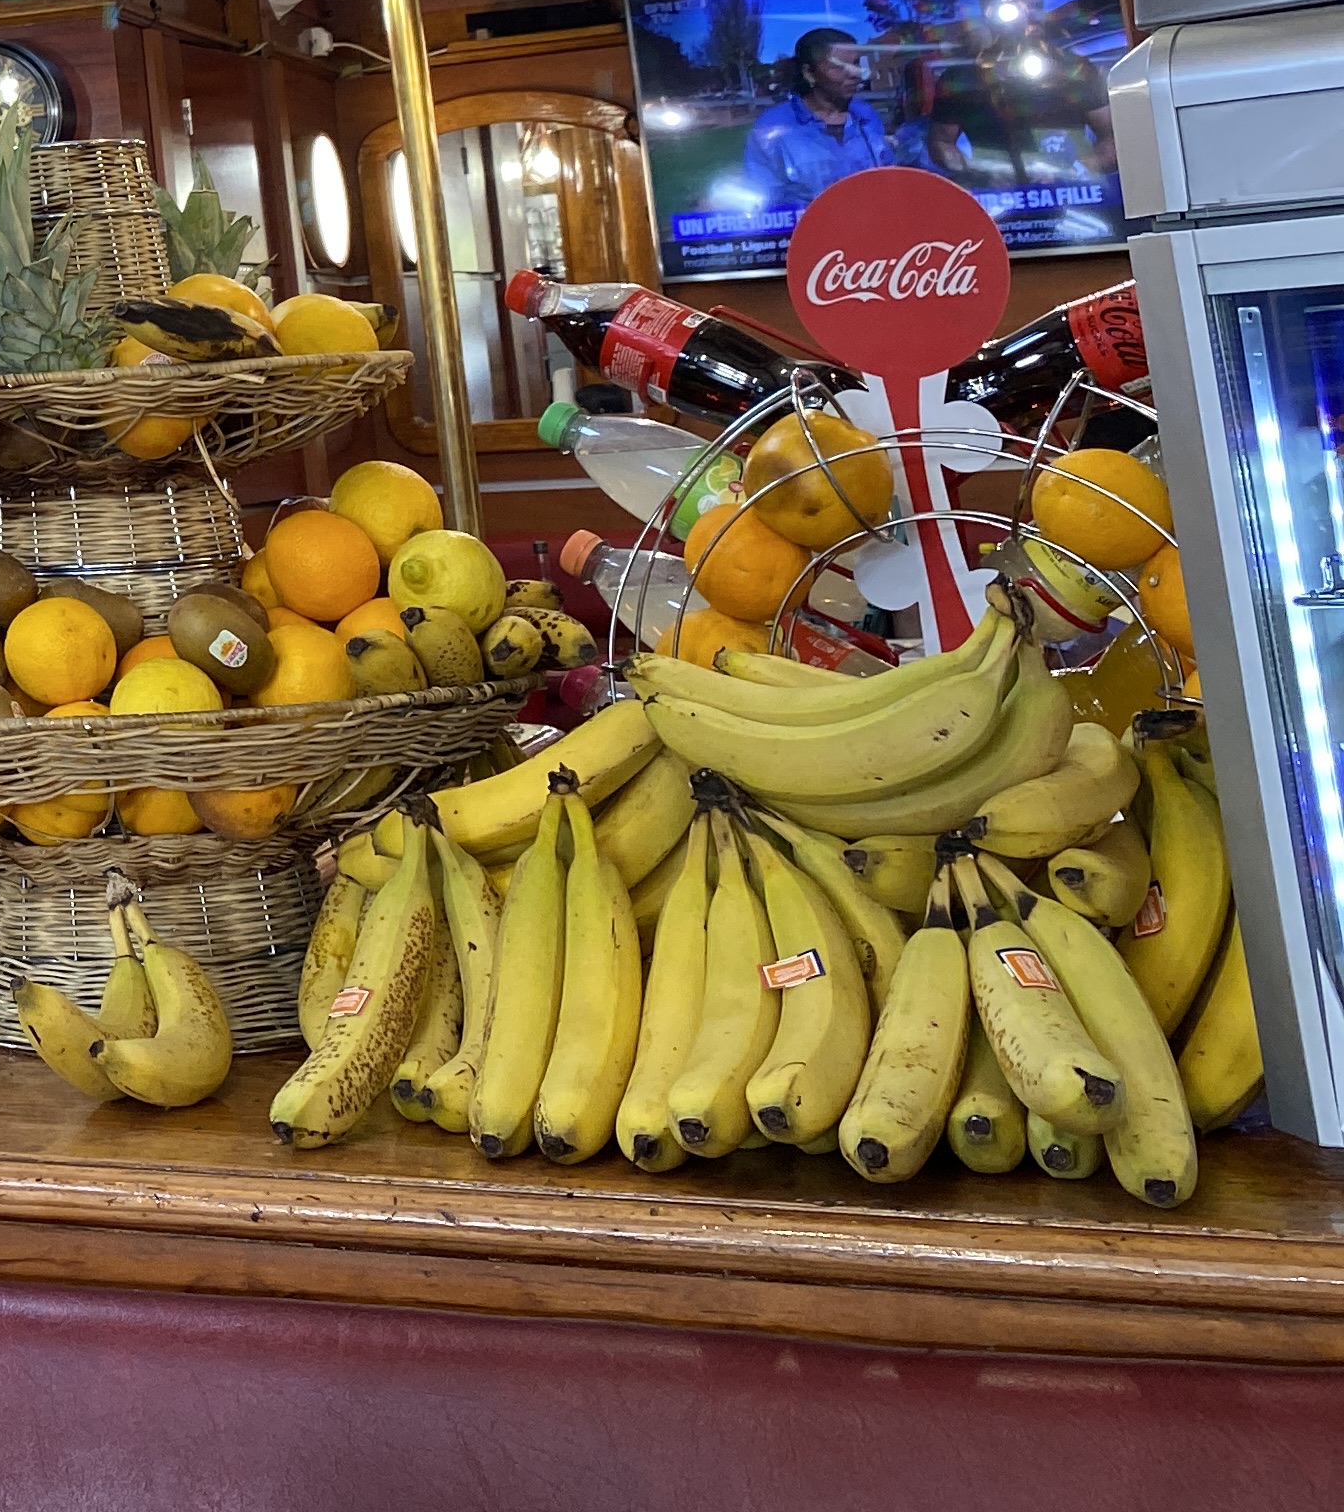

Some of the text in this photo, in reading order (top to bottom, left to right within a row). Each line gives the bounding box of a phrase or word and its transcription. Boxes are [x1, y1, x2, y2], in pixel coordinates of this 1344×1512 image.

[1027, 189, 1054, 208] SA
[1056, 185, 1103, 206] FILLE
[678, 218, 703, 236] UN
[681, 242, 733, 256] Football
[742, 240, 776, 253] Ligue
[806, 238, 984, 305] Coca-Cola
